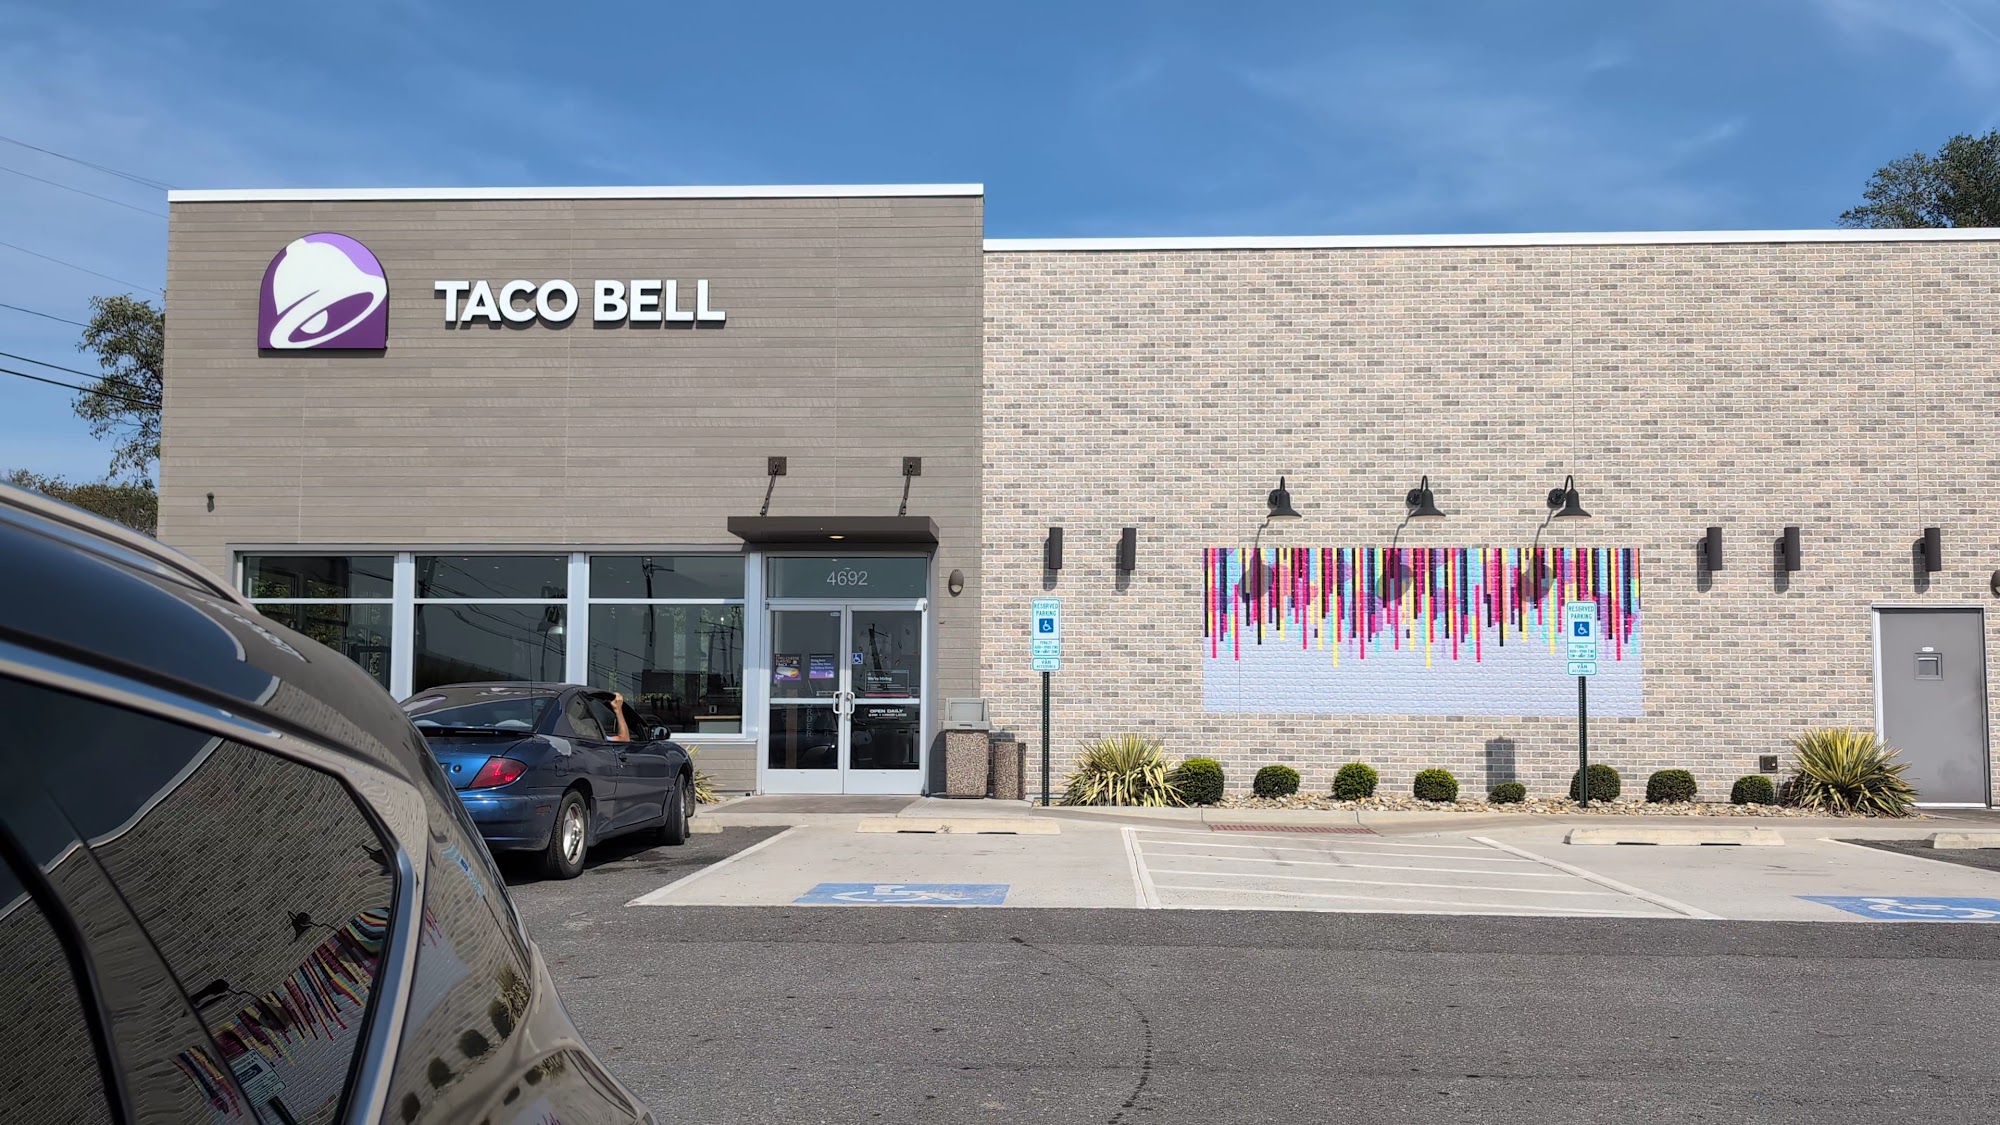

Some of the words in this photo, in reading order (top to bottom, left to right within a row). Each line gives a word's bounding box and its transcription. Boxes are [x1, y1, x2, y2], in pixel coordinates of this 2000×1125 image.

[434, 279, 579, 322] TACO
[594, 279, 726, 322] BELL
[826, 570, 868, 586] 4692
